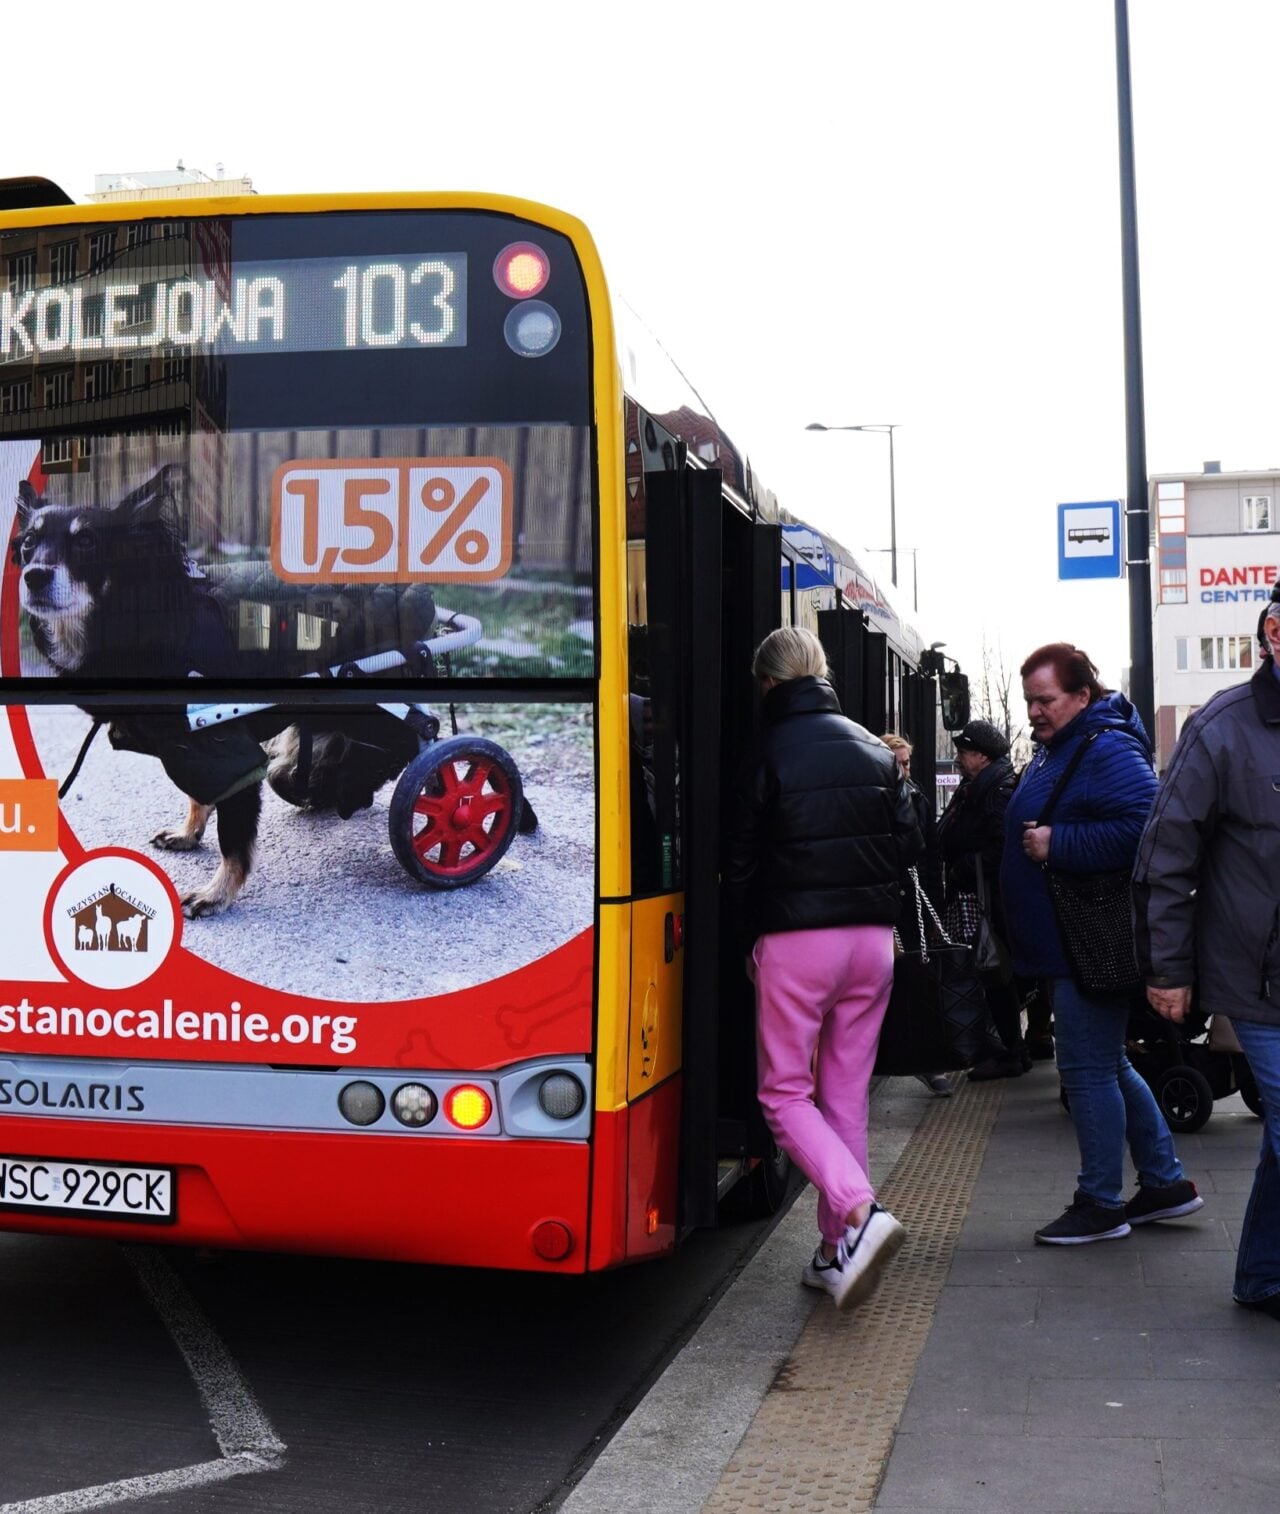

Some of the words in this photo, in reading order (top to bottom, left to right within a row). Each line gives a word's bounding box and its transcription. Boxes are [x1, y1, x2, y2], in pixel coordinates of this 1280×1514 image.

[0, 276, 285, 354] KOLEJOWA
[333, 260, 455, 347] 103
[62, 1167, 166, 1212] 929CK
